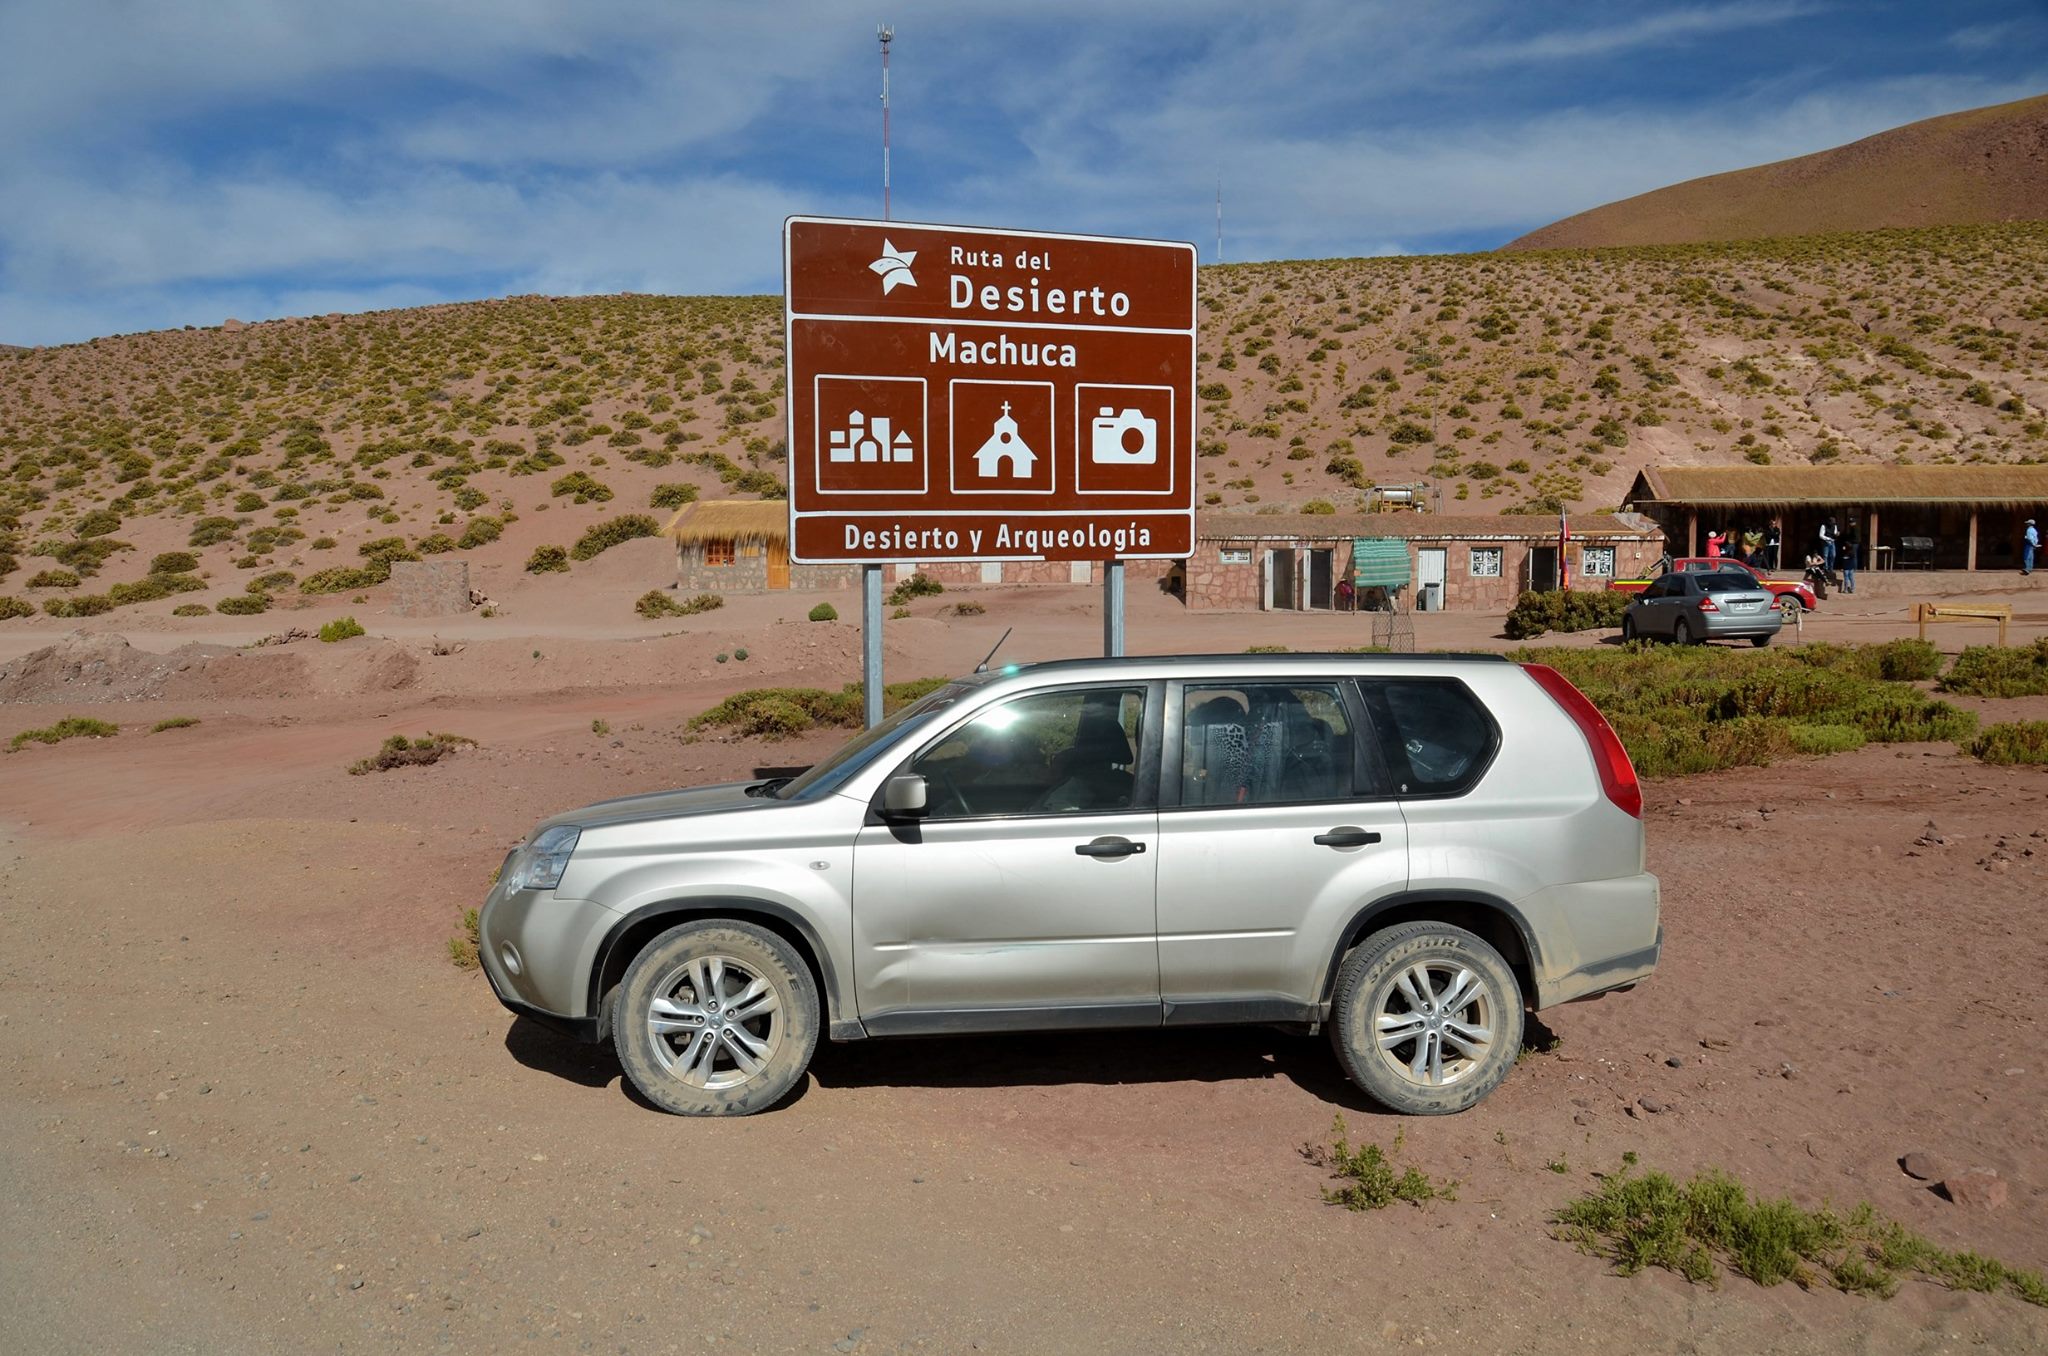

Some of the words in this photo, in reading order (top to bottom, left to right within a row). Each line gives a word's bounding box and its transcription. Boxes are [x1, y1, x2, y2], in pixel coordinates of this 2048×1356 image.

[951, 246, 1003, 268] Ruta
[1015, 250, 1051, 271] del
[950, 274, 1130, 317] Desierto
[929, 331, 1077, 368] Machuca
[845, 524, 959, 550] Desierto
[969, 529, 983, 553] y
[995, 521, 1151, 553] Arqueología
[1370, 936, 1469, 984] SAPPHIRE
